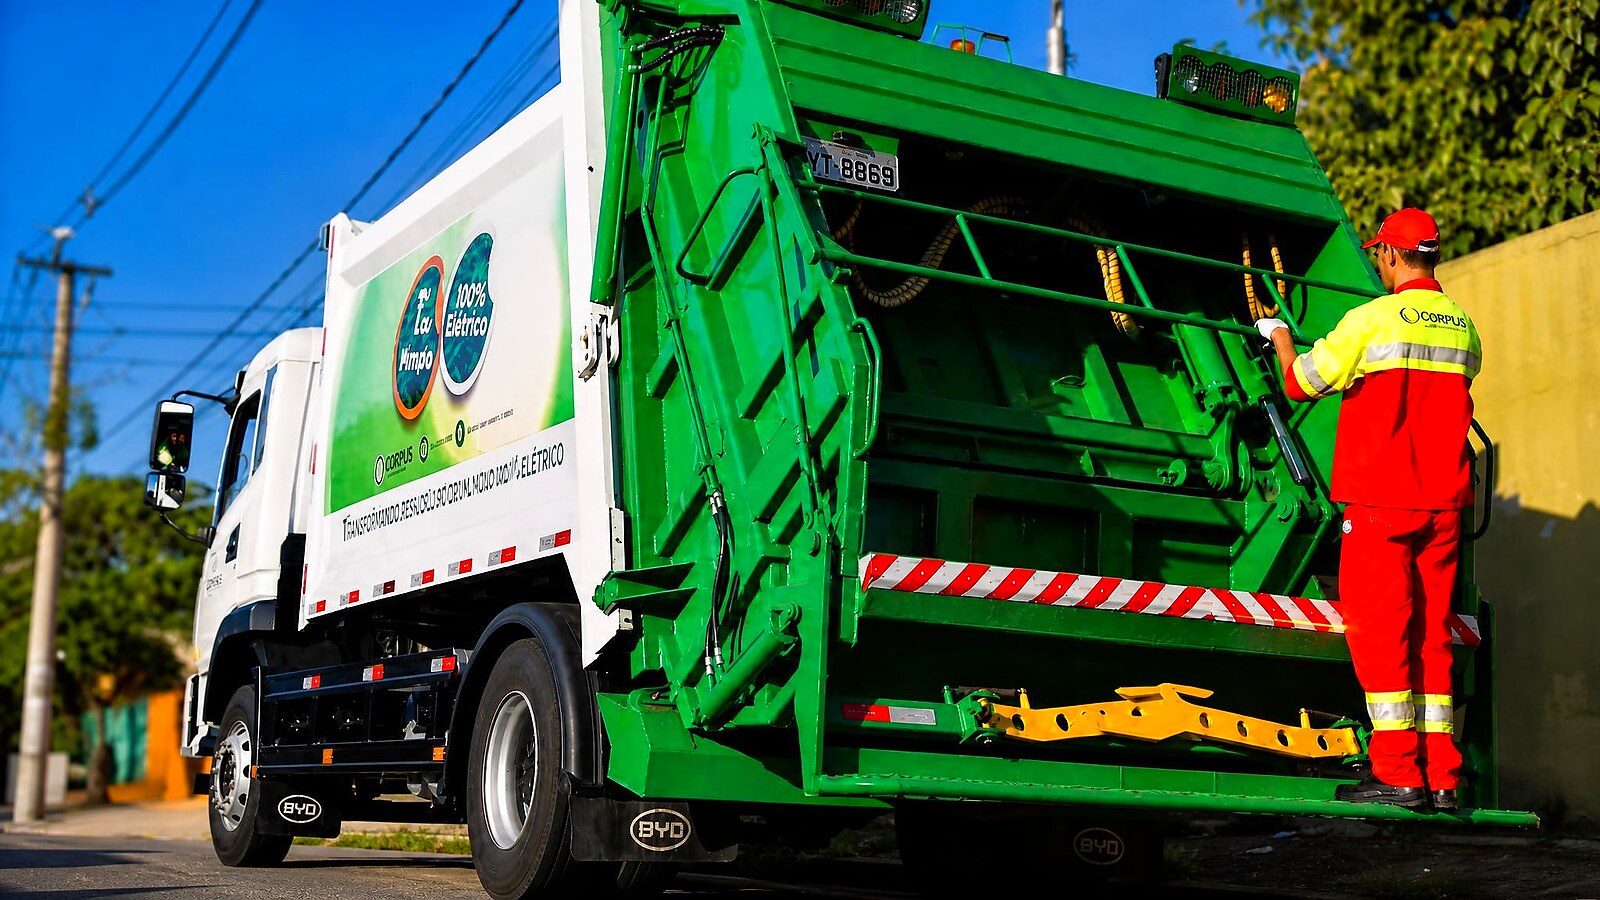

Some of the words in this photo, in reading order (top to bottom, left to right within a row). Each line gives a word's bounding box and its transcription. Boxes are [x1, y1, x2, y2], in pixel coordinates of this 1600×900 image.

[807, 151, 894, 187] YT-8869
[455, 281, 487, 309] 100%
[1420, 311, 1467, 329] CORPUS
[385, 446, 413, 472] CORPUS
[521, 442, 564, 479] ELÉTRICO
[283, 802, 316, 815] BYD
[638, 820, 684, 838] BYD
[1080, 838, 1118, 855] BYD
